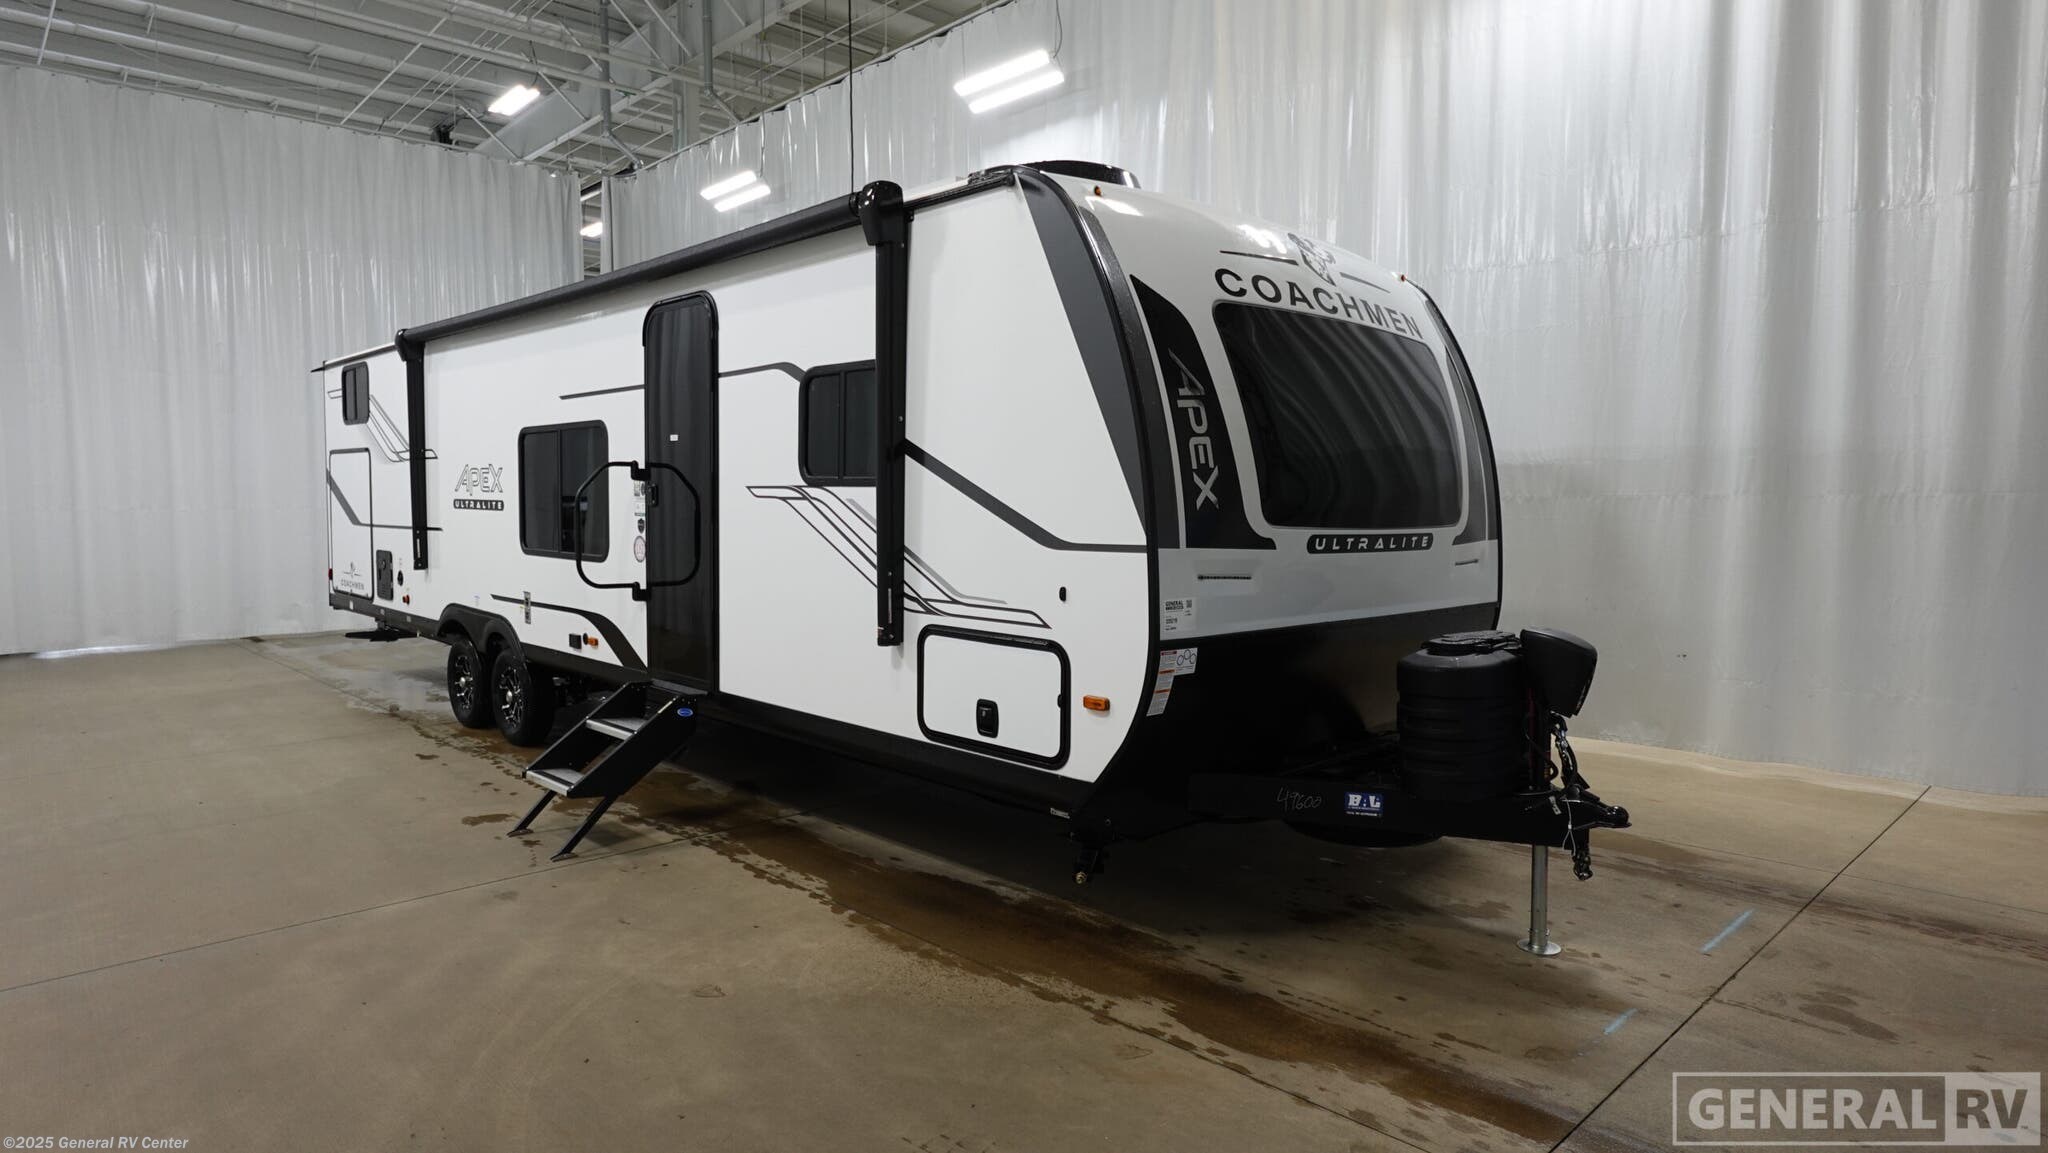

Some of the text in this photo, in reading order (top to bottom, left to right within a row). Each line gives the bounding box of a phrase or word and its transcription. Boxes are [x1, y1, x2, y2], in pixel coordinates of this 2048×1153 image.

[1214, 268, 1424, 340] COACHMEN
[1170, 350, 1219, 510] APEX
[454, 463, 503, 496] APEX
[455, 500, 503, 510] ULTRALITE
[1315, 536, 1429, 550] ULTRALITE
